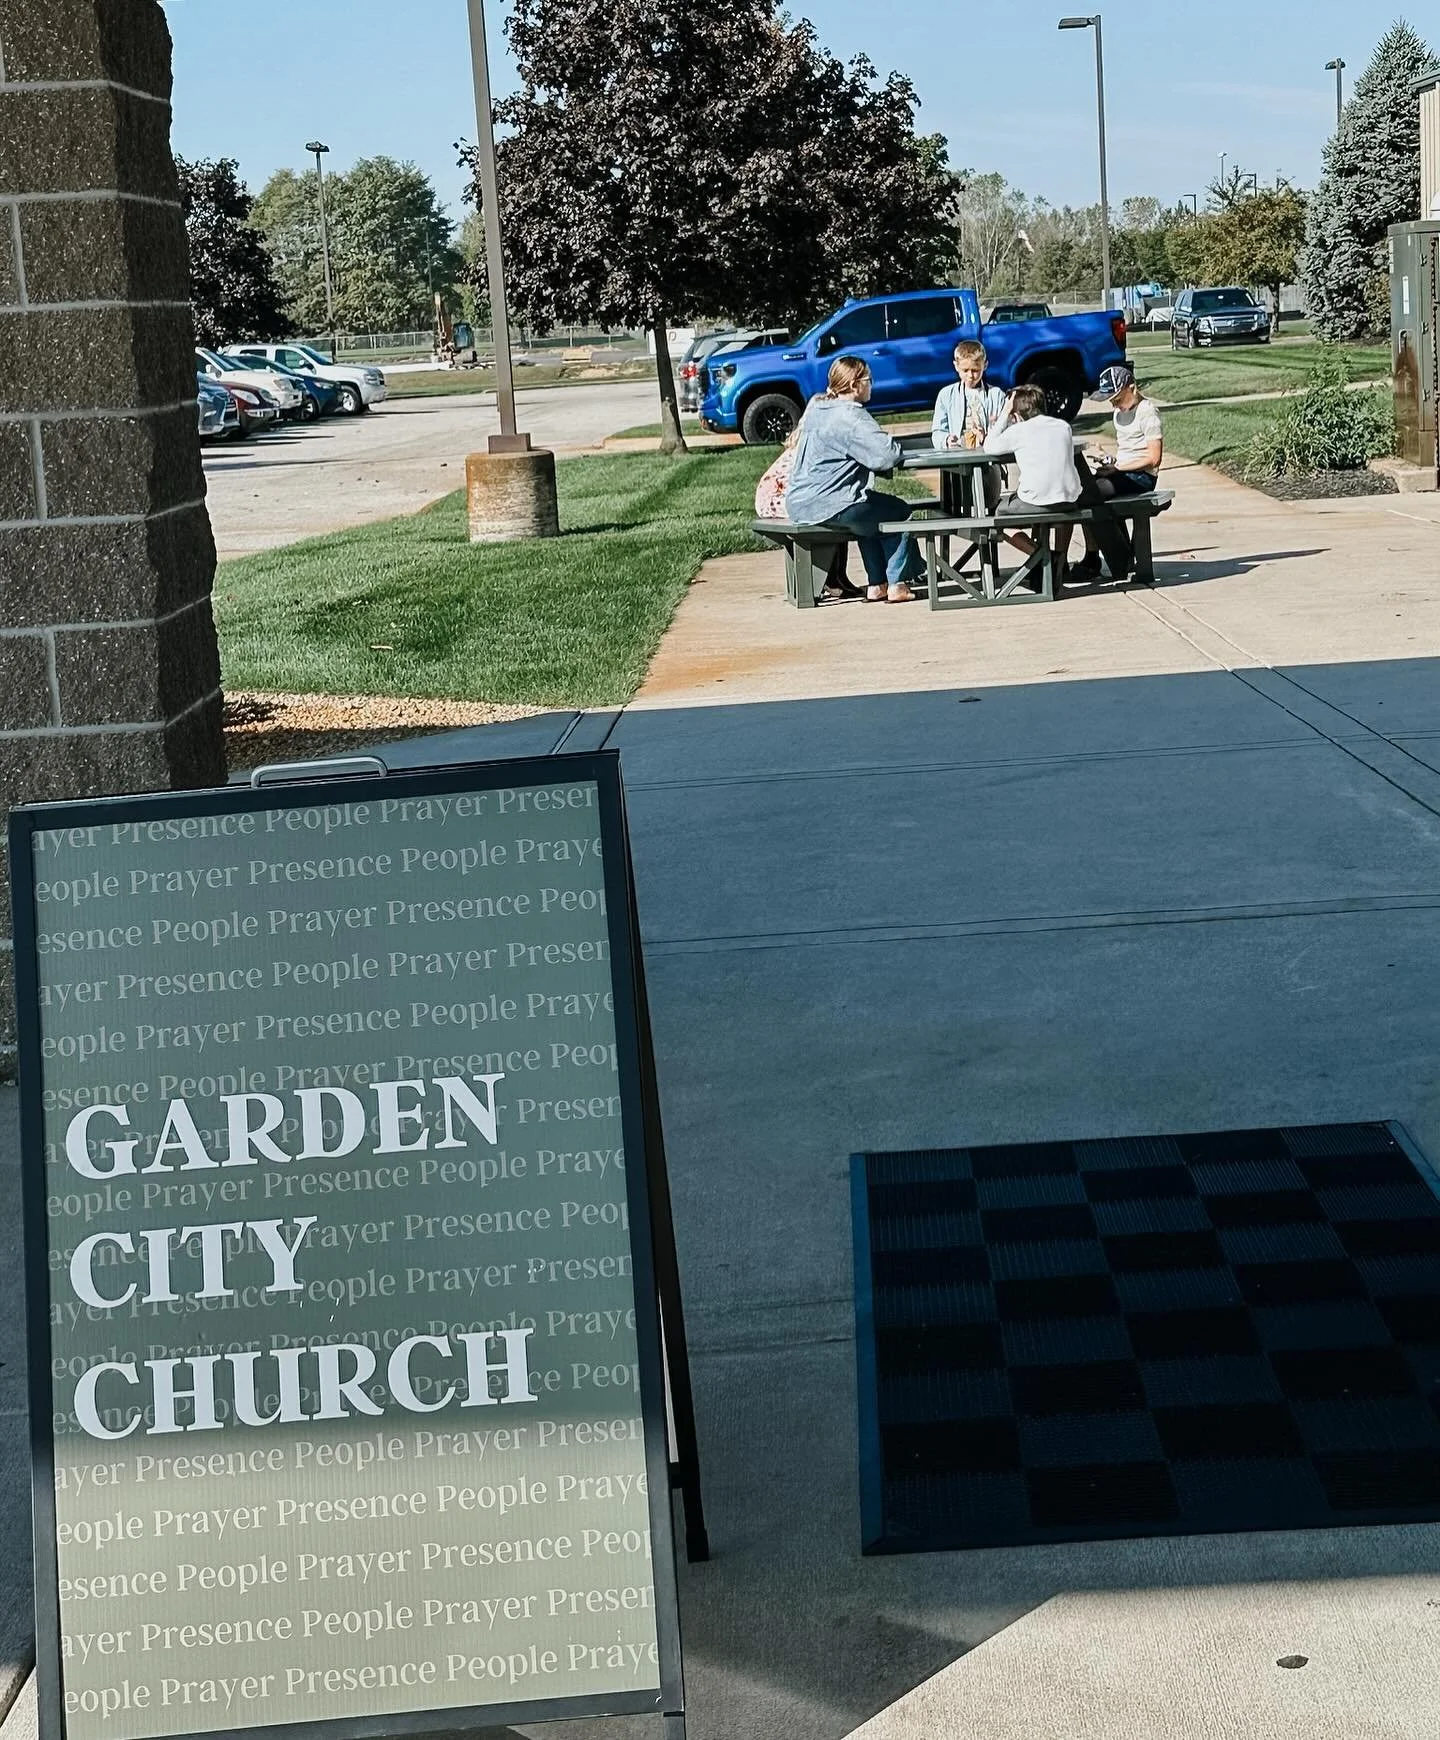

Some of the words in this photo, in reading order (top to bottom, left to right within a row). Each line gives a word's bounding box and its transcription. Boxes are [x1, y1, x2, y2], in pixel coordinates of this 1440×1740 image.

[111, 813, 255, 845] Presence
[265, 804, 370, 835] People
[380, 795, 487, 826] Prayer
[35, 871, 120, 907] eople
[129, 866, 239, 897] Prayer
[248, 853, 392, 885] Presence
[401, 840, 507, 875] People
[515, 837, 602, 866] Praye
[38, 925, 142, 954] esence
[152, 911, 259, 947] People
[267, 906, 377, 937] Prayer
[386, 893, 530, 926] Presence
[40, 979, 108, 1012] ayer
[117, 967, 262, 999] Presence
[272, 953, 379, 989] People
[388, 949, 498, 980] Prayer
[41, 1026, 126, 1063] eople
[135, 1021, 246, 1053] Prayer
[256, 1007, 401, 1040] Presence
[409, 994, 517, 1030] People
[526, 991, 614, 1021] Praye
[42, 1080, 149, 1111] esence
[159, 1066, 266, 1100] People
[275, 1061, 386, 1091] Prayer
[395, 1049, 541, 1080] Presence
[66, 1073, 505, 1180] GARDEN
[400, 1104, 507, 1137] Prayr
[46, 1183, 132, 1222] eople
[142, 1178, 254, 1212] Prayer
[263, 1164, 409, 1199] Presence
[419, 1152, 527, 1188] People
[536, 1148, 626, 1180] Praye
[403, 1206, 551, 1240] Presence
[70, 1215, 318, 1309] CITY
[406, 1262, 517, 1296] Prayer
[545, 1307, 637, 1341] Praye
[74, 1327, 539, 1440] CHURCH
[55, 1461, 125, 1497] ayer
[135, 1448, 284, 1482] Presence
[295, 1433, 404, 1471] People
[414, 1427, 527, 1462] Prayer
[58, 1511, 144, 1551] eople
[153, 1504, 267, 1541] Prayer
[277, 1490, 427, 1526] Presence
[436, 1476, 547, 1516] People
[557, 1472, 648, 1505] Praye
[59, 1570, 167, 1601] esence
[176, 1555, 288, 1594] People
[298, 1548, 411, 1585] Prayer
[421, 1535, 572, 1569] Presence
[61, 1629, 132, 1665] ayer
[141, 1616, 292, 1651] Presence
[301, 1601, 413, 1639] People
[422, 1595, 537, 1631] Prayer
[65, 1680, 151, 1719] eople
[160, 1673, 275, 1711] Prayer
[285, 1660, 436, 1696] Presence
[446, 1645, 558, 1685] People
[568, 1641, 660, 1675] Praye
